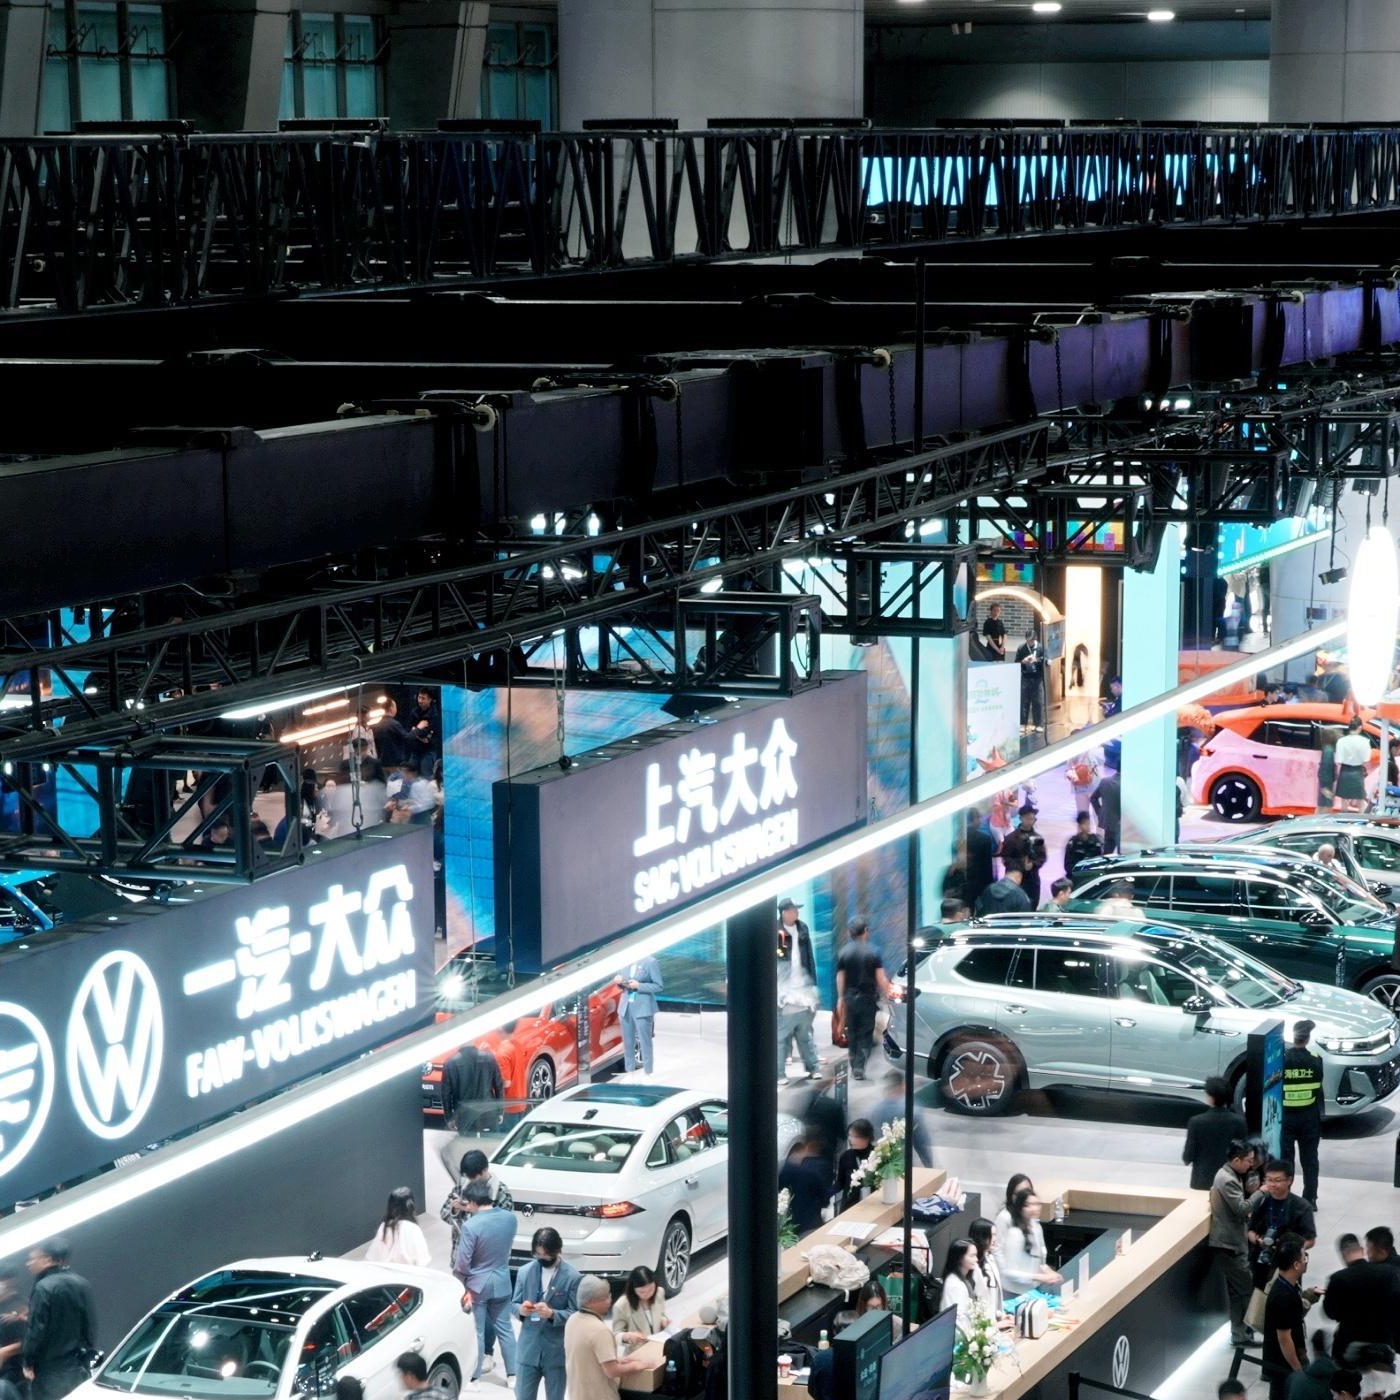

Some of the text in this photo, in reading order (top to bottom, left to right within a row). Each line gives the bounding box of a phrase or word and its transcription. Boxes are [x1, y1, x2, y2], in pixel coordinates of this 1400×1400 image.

[633, 717, 798, 857] 上汽大众
[634, 808, 799, 914] SAIC VOLKSWAGEN
[185, 969, 417, 1098] FAW-VOLKSWAGEN
